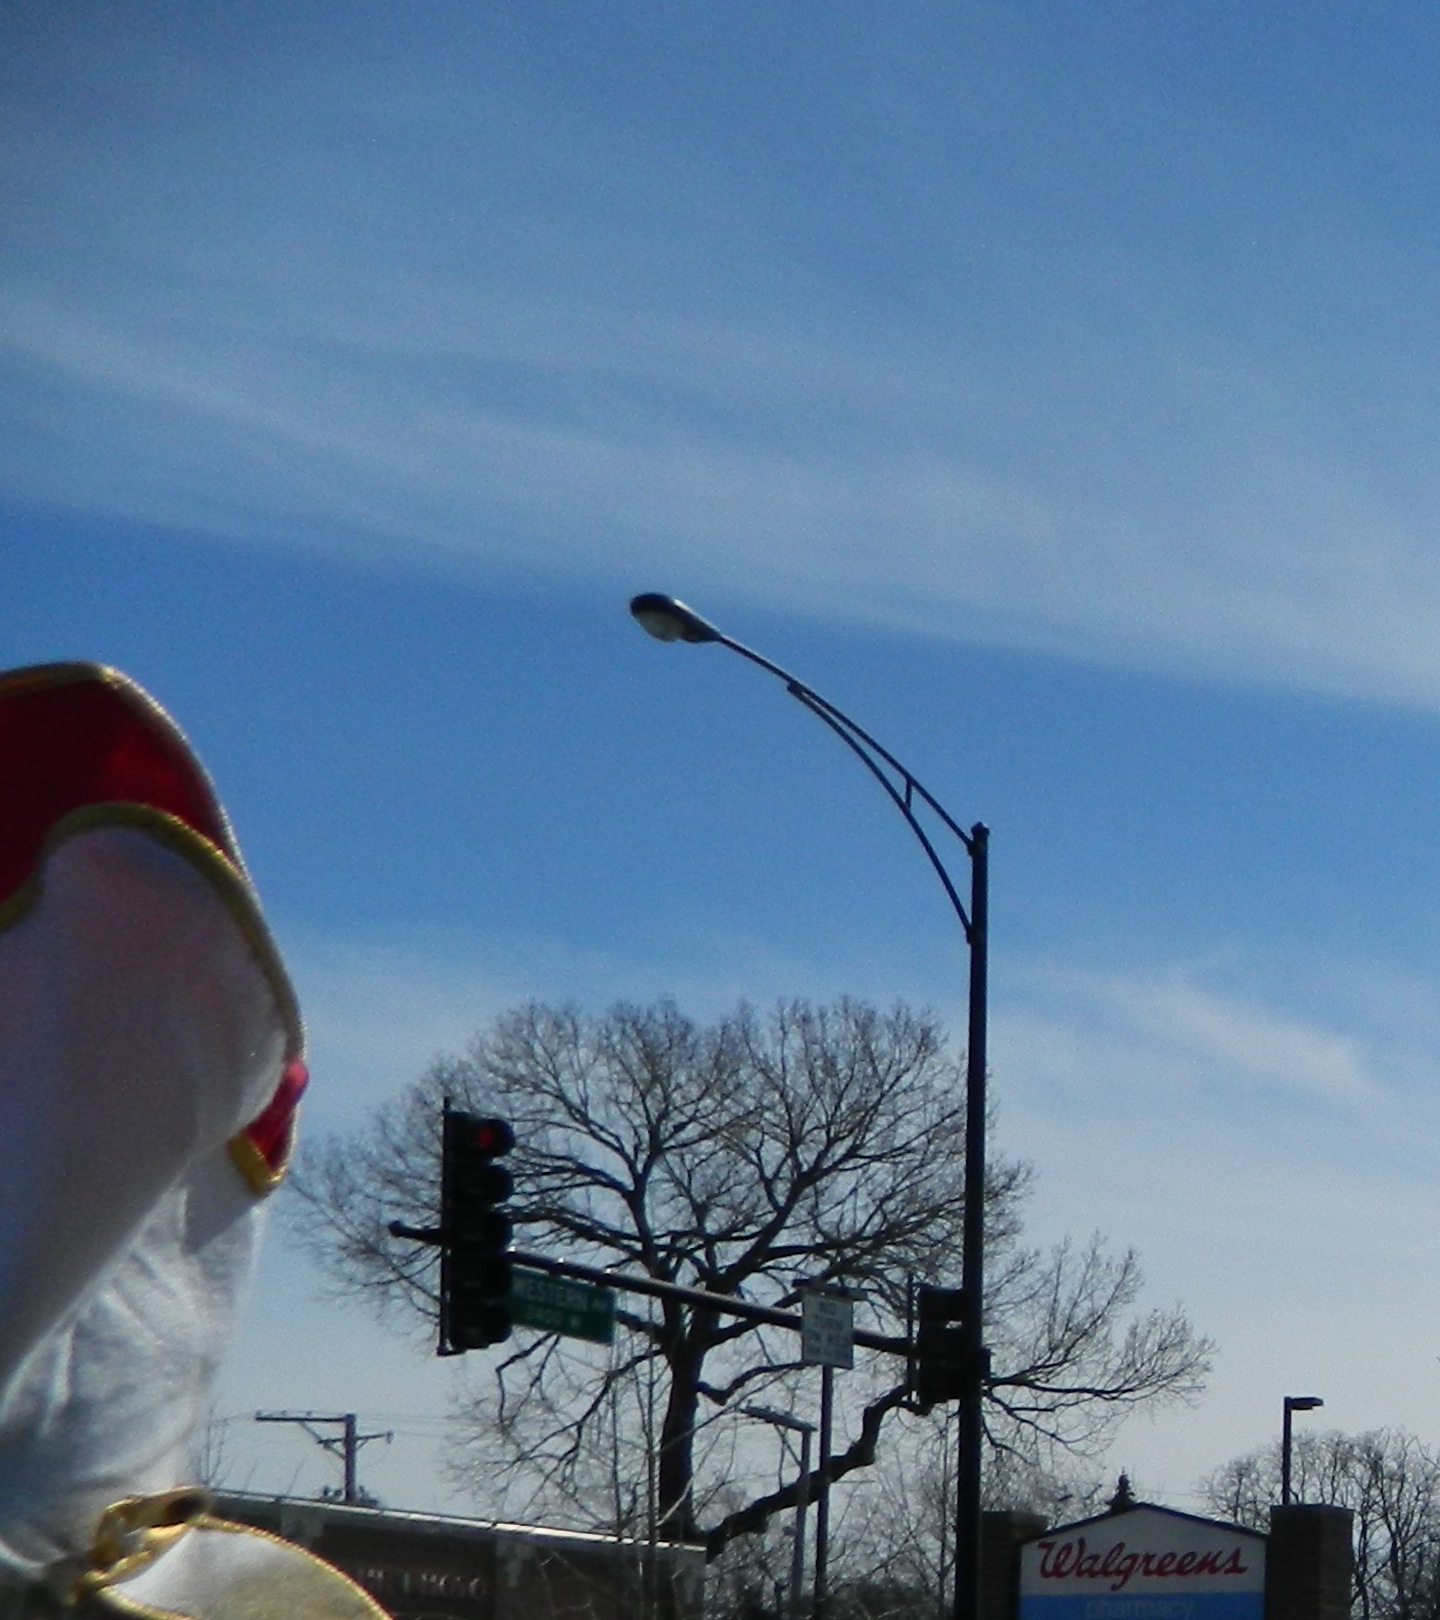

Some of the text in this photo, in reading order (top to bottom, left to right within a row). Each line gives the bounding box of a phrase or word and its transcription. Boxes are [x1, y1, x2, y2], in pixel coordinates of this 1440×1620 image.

[511, 1275, 588, 1313] WESTERN
[1038, 1537, 1248, 1591] Walgreens
[1085, 1598, 1196, 1620] pharmacy
